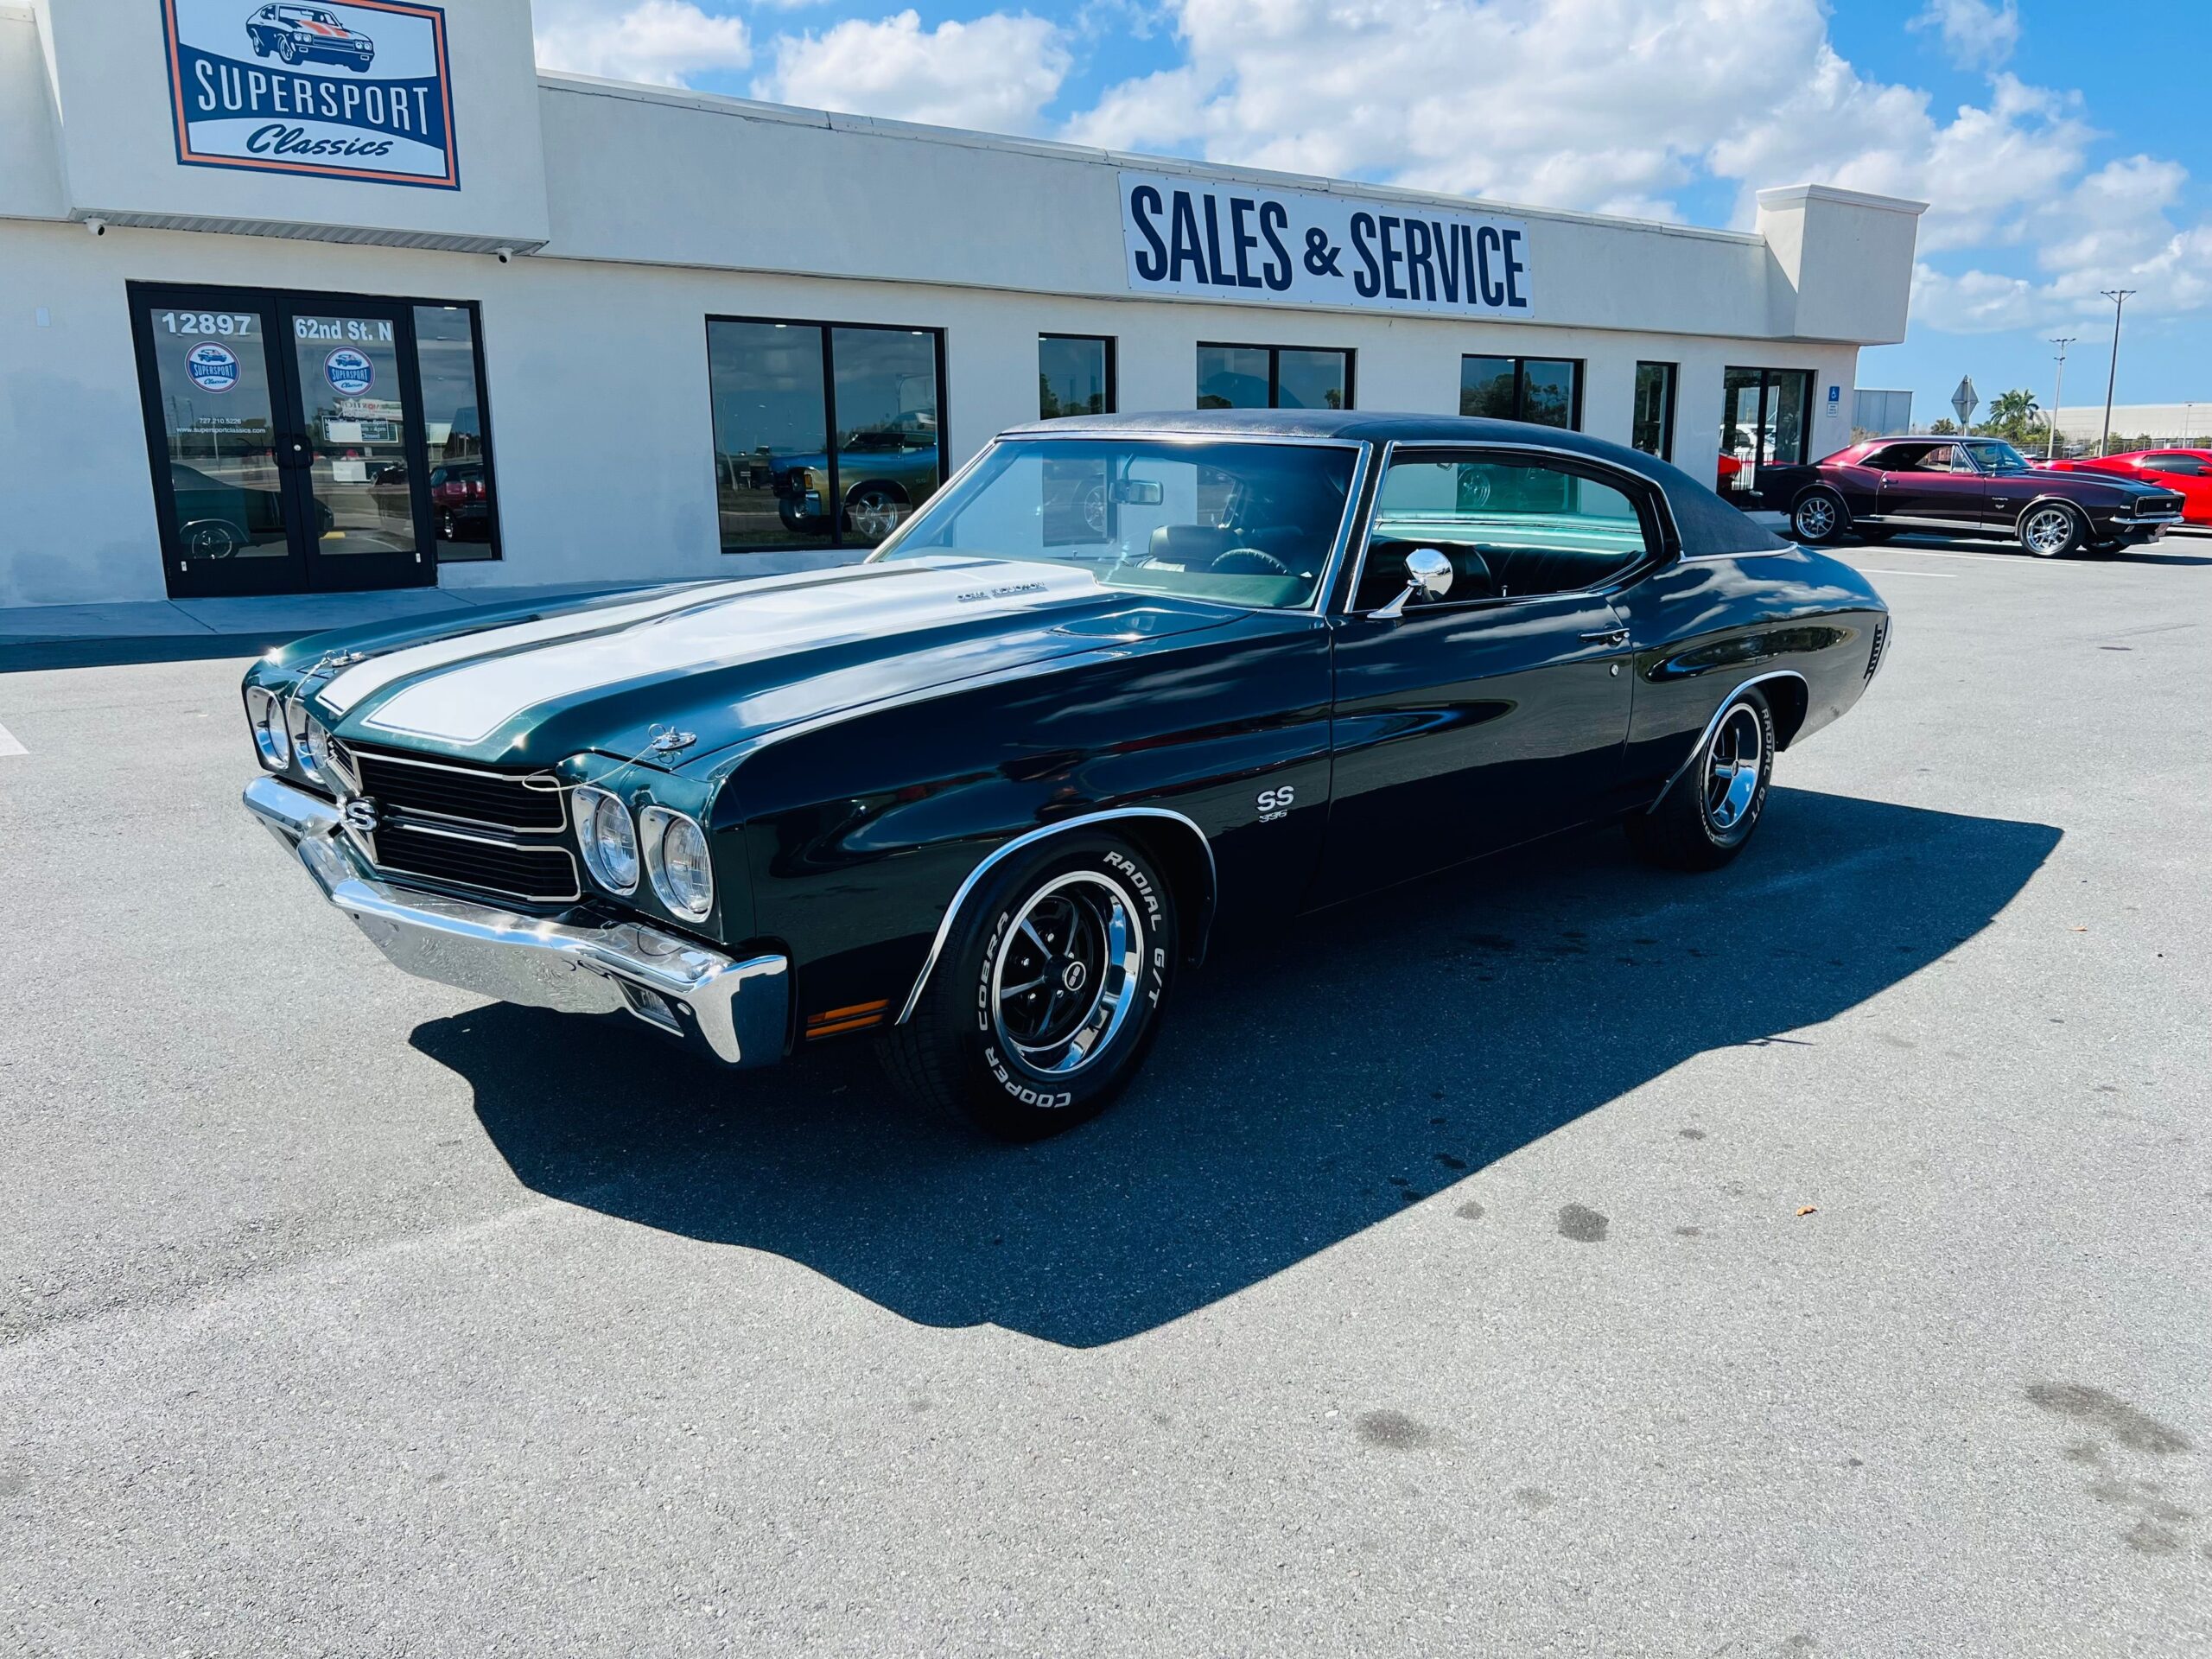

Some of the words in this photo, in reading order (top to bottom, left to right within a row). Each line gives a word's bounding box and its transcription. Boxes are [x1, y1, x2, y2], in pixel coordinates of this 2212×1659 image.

[195, 59, 429, 135] SUPERSPORT
[246, 124, 394, 156] Classics
[1130, 185, 1293, 291] SALES
[1304, 227, 1344, 277] &
[1350, 212, 1528, 308] SERVICE
[162, 312, 251, 335] 12897
[296, 319, 342, 340] 62nd
[347, 321, 373, 340] St.
[378, 322, 392, 341] N
[194, 364, 233, 378] SUPERSPORT
[332, 368, 368, 380] SUPERSPORT
[1762, 709, 1772, 776] RADIAL
[1256, 785, 1294, 811] SS
[1103, 851, 1165, 932] RADIAL
[978, 912, 1009, 1031] COBRA
[1148, 948, 1165, 1008] G/T
[985, 1046, 1071, 1109] COOPER
